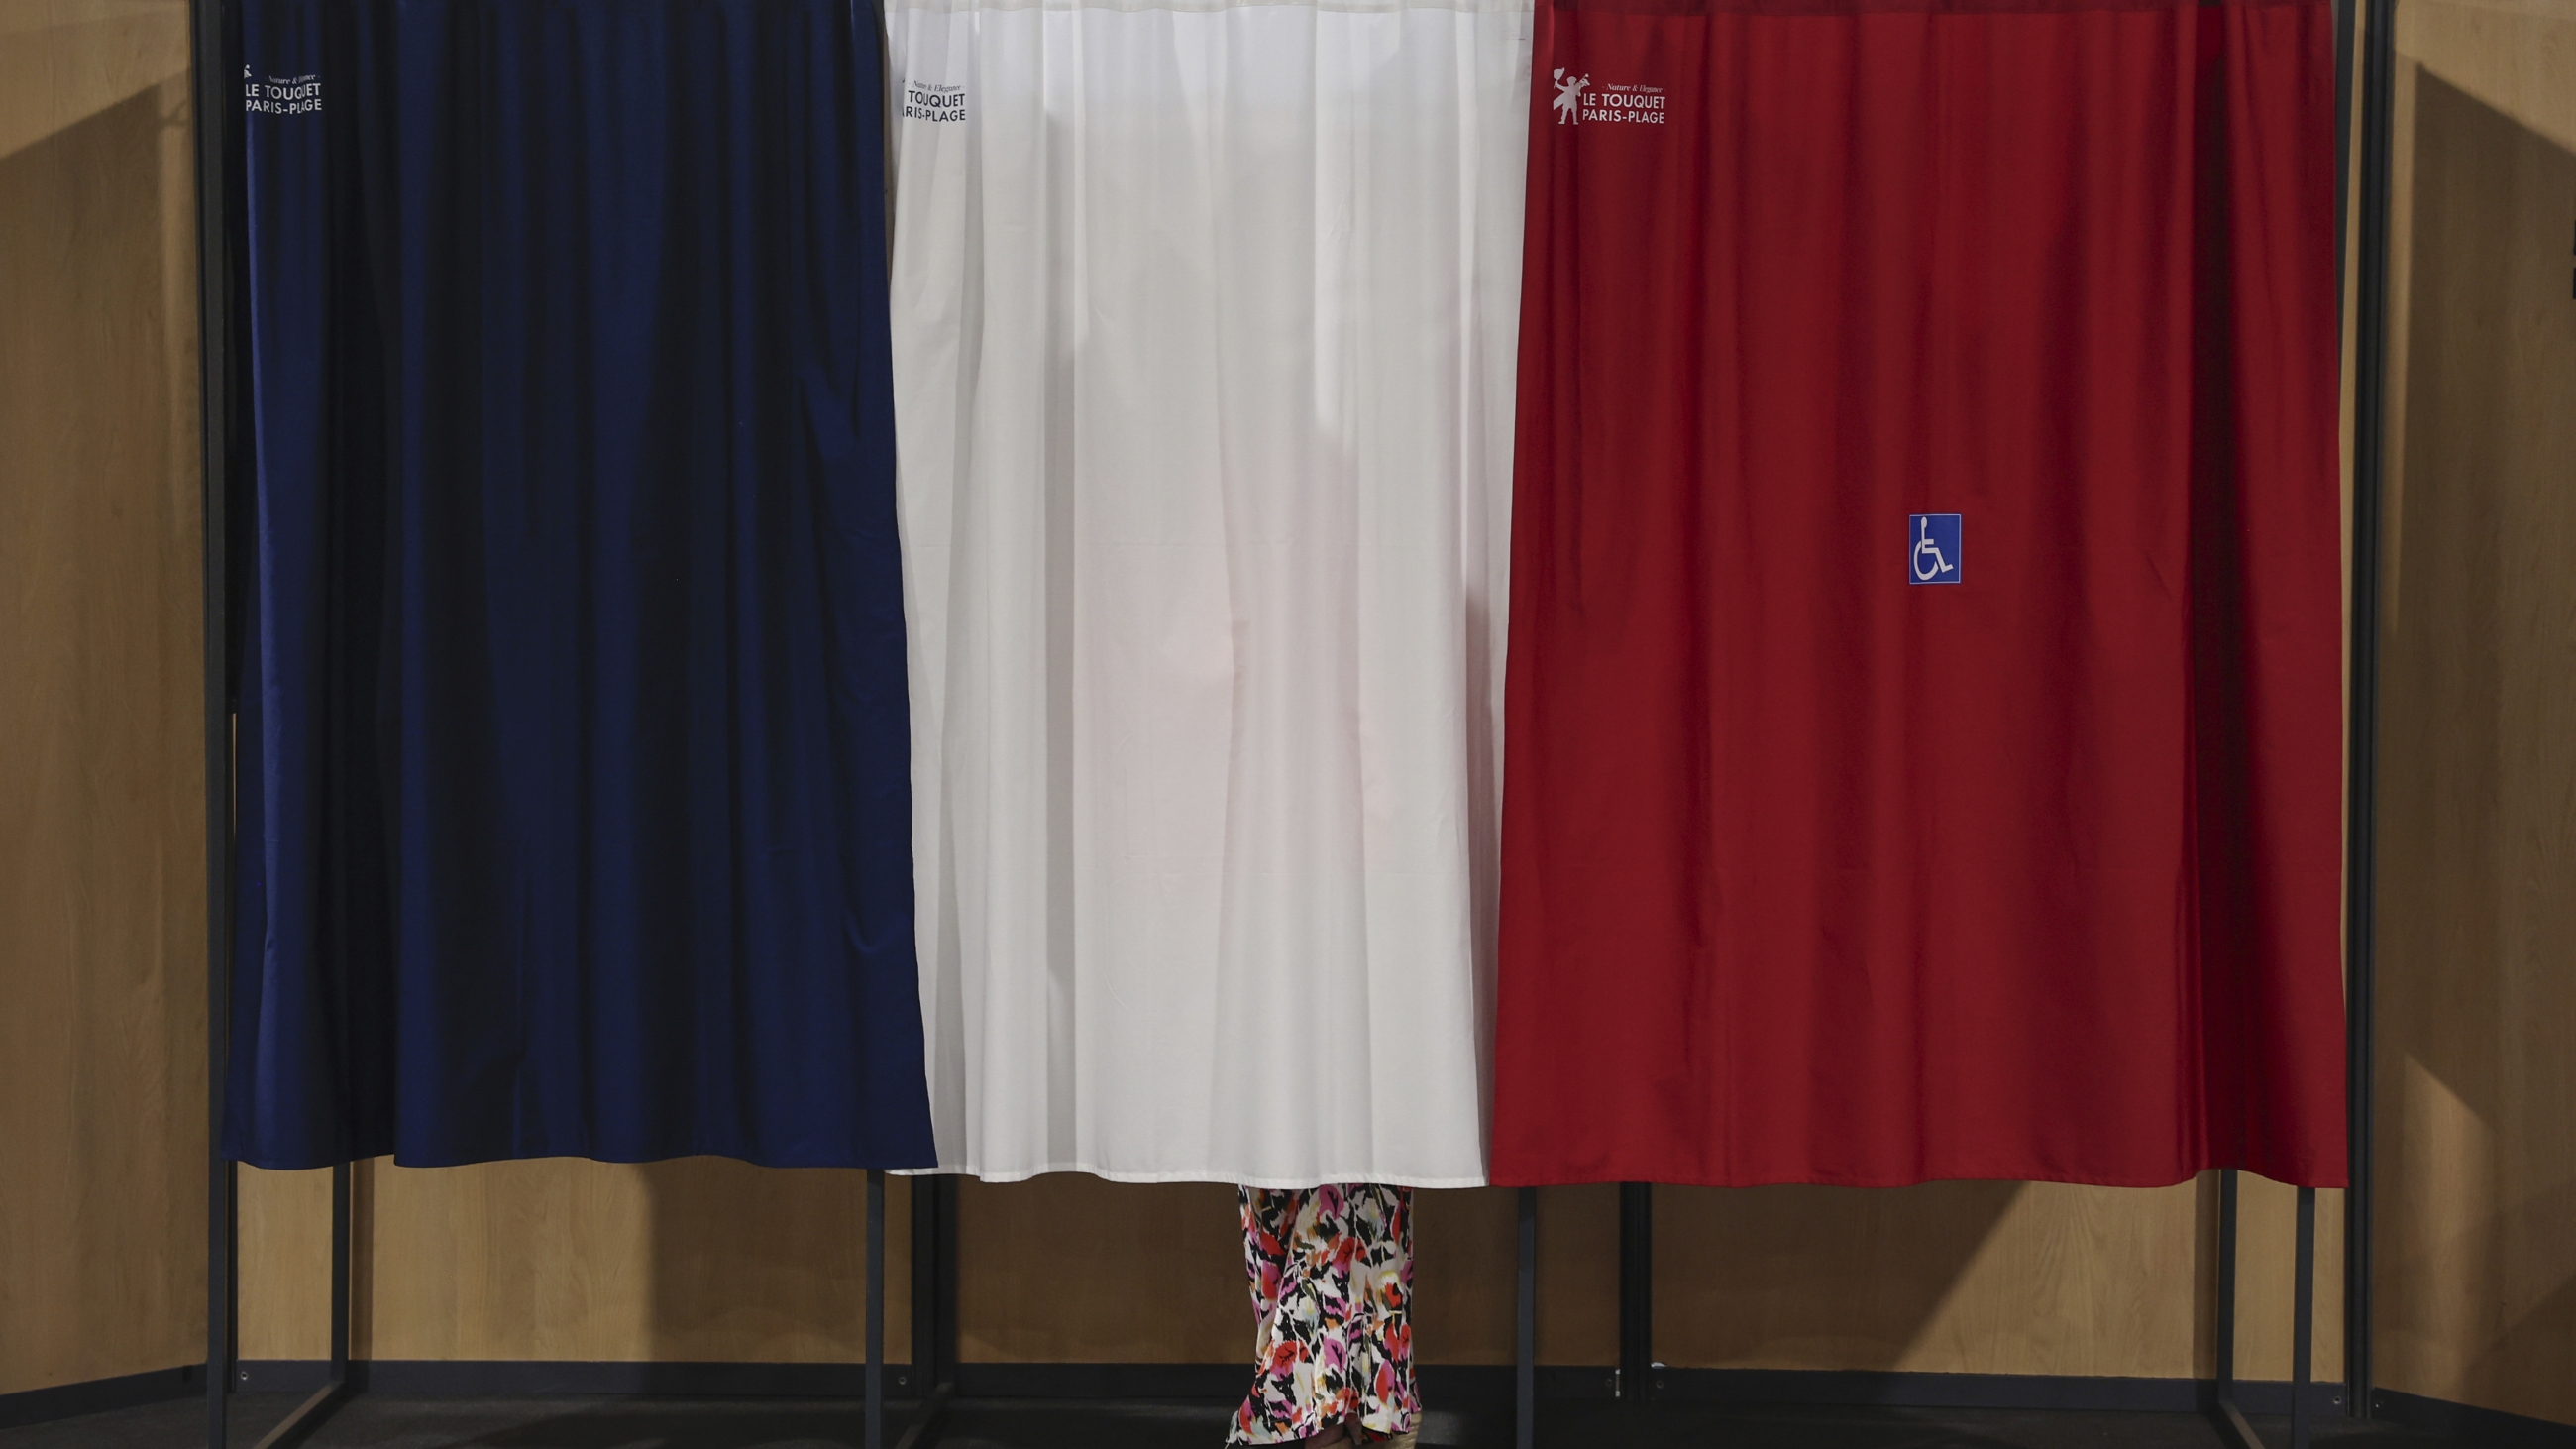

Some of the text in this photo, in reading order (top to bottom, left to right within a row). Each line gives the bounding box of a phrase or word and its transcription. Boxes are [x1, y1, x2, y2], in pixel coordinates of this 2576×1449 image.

[245, 83, 321, 100] LE TOUQUET
[1606, 83, 1631, 92] Nature
[246, 99, 322, 114] PARIS-PLAGE
[908, 90, 965, 108] TOUQUET
[1583, 93, 1666, 109] LE TOUQUET
[903, 106, 966, 122] RIS-PLAGE
[1582, 108, 1664, 124] PARIS-PLAGE
